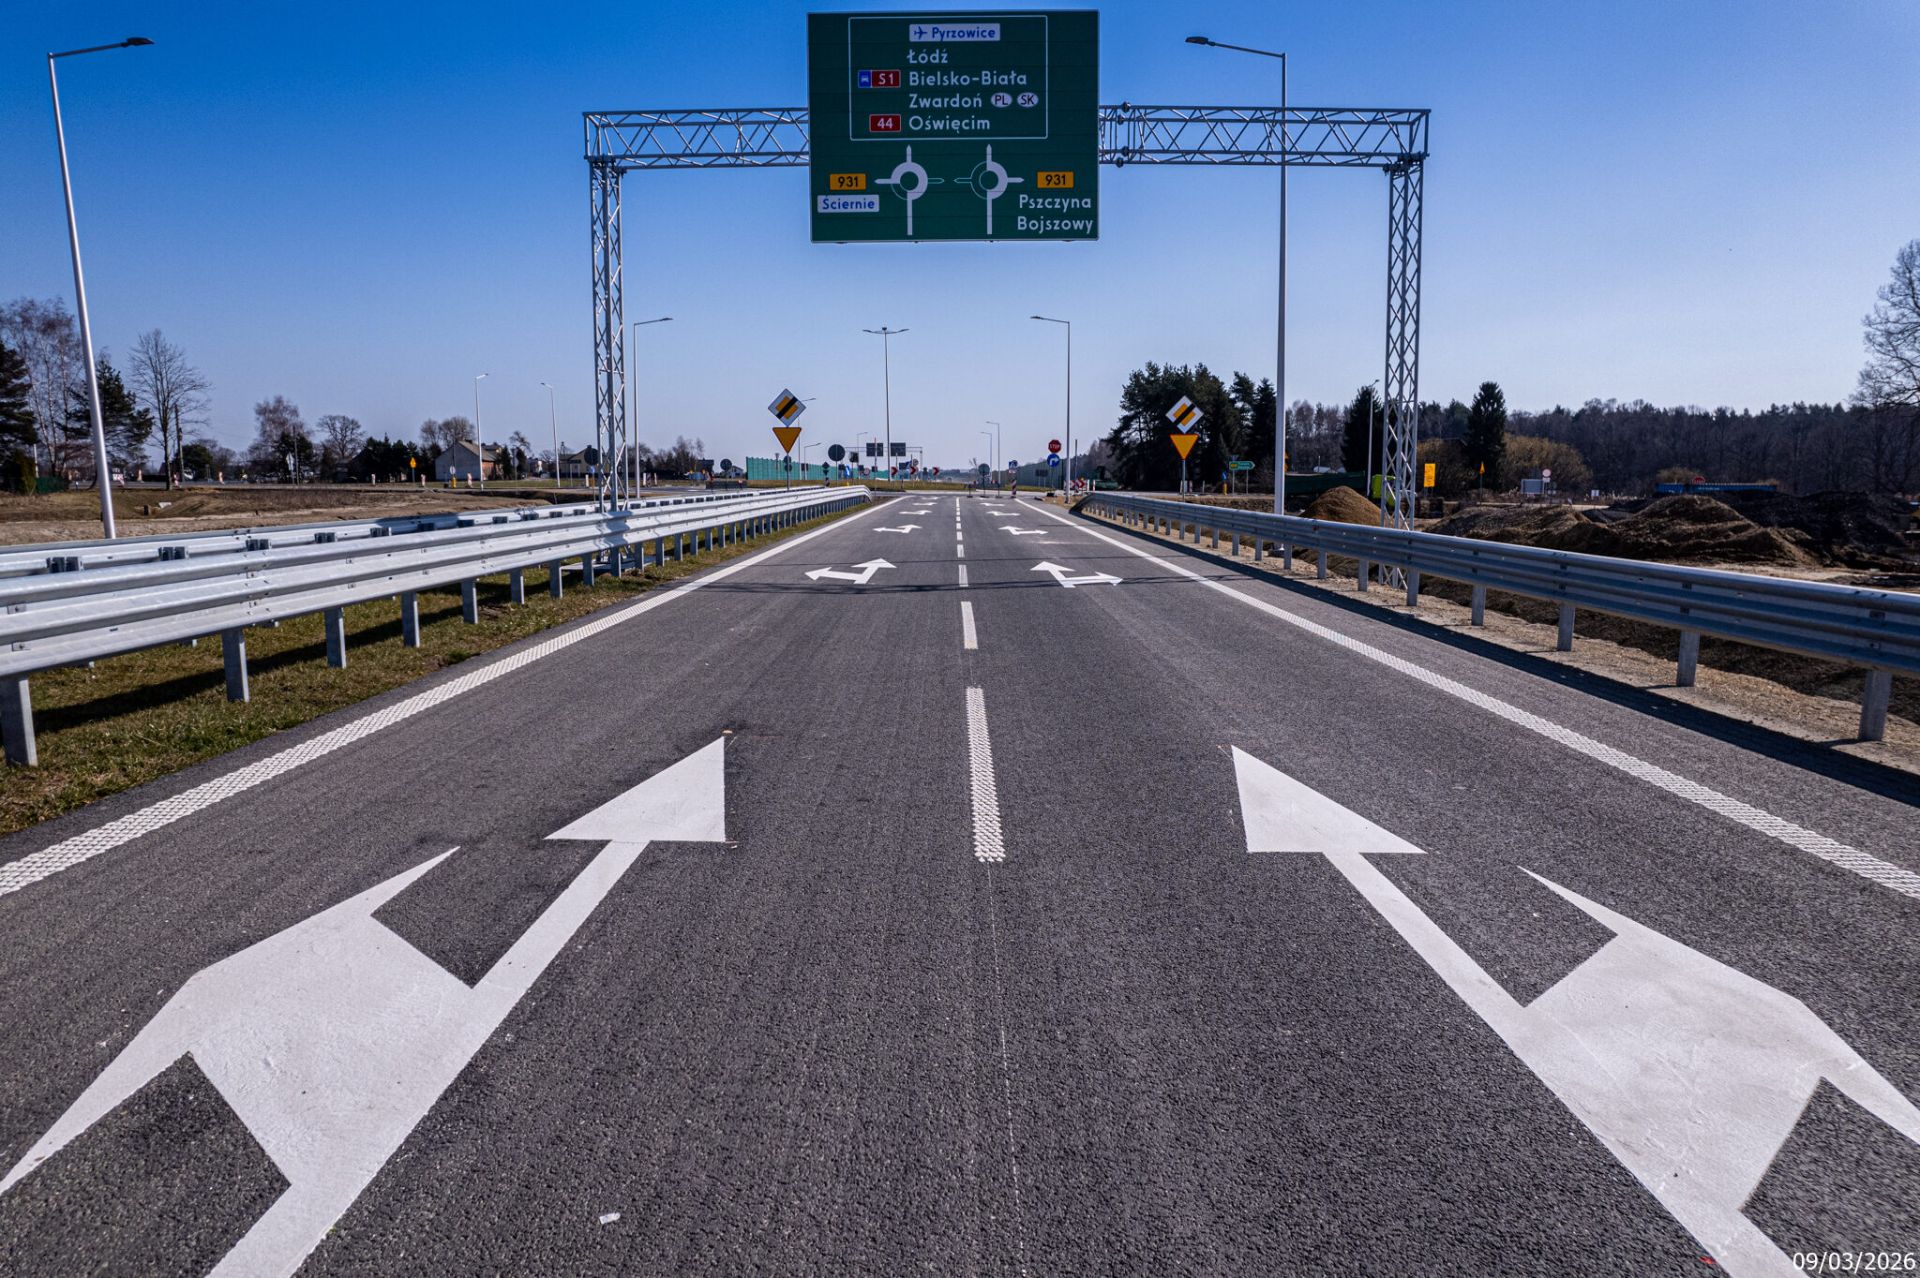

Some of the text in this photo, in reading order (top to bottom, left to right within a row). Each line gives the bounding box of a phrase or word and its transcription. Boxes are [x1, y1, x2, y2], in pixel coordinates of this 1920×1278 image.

[932, 27, 996, 41] Pyrzowice
[907, 49, 948, 64] Łódź
[879, 70, 1027, 86] S1 Bielsko-Biała
[909, 93, 1034, 108] Zwardoń PL SK
[877, 115, 990, 133] 44 Oświęcim
[838, 175, 859, 188] 931
[1045, 174, 1066, 186] 931
[822, 194, 875, 210] Ściernie
[1019, 194, 1092, 213] Pszczyna
[1017, 216, 1093, 234] Bojszowy
